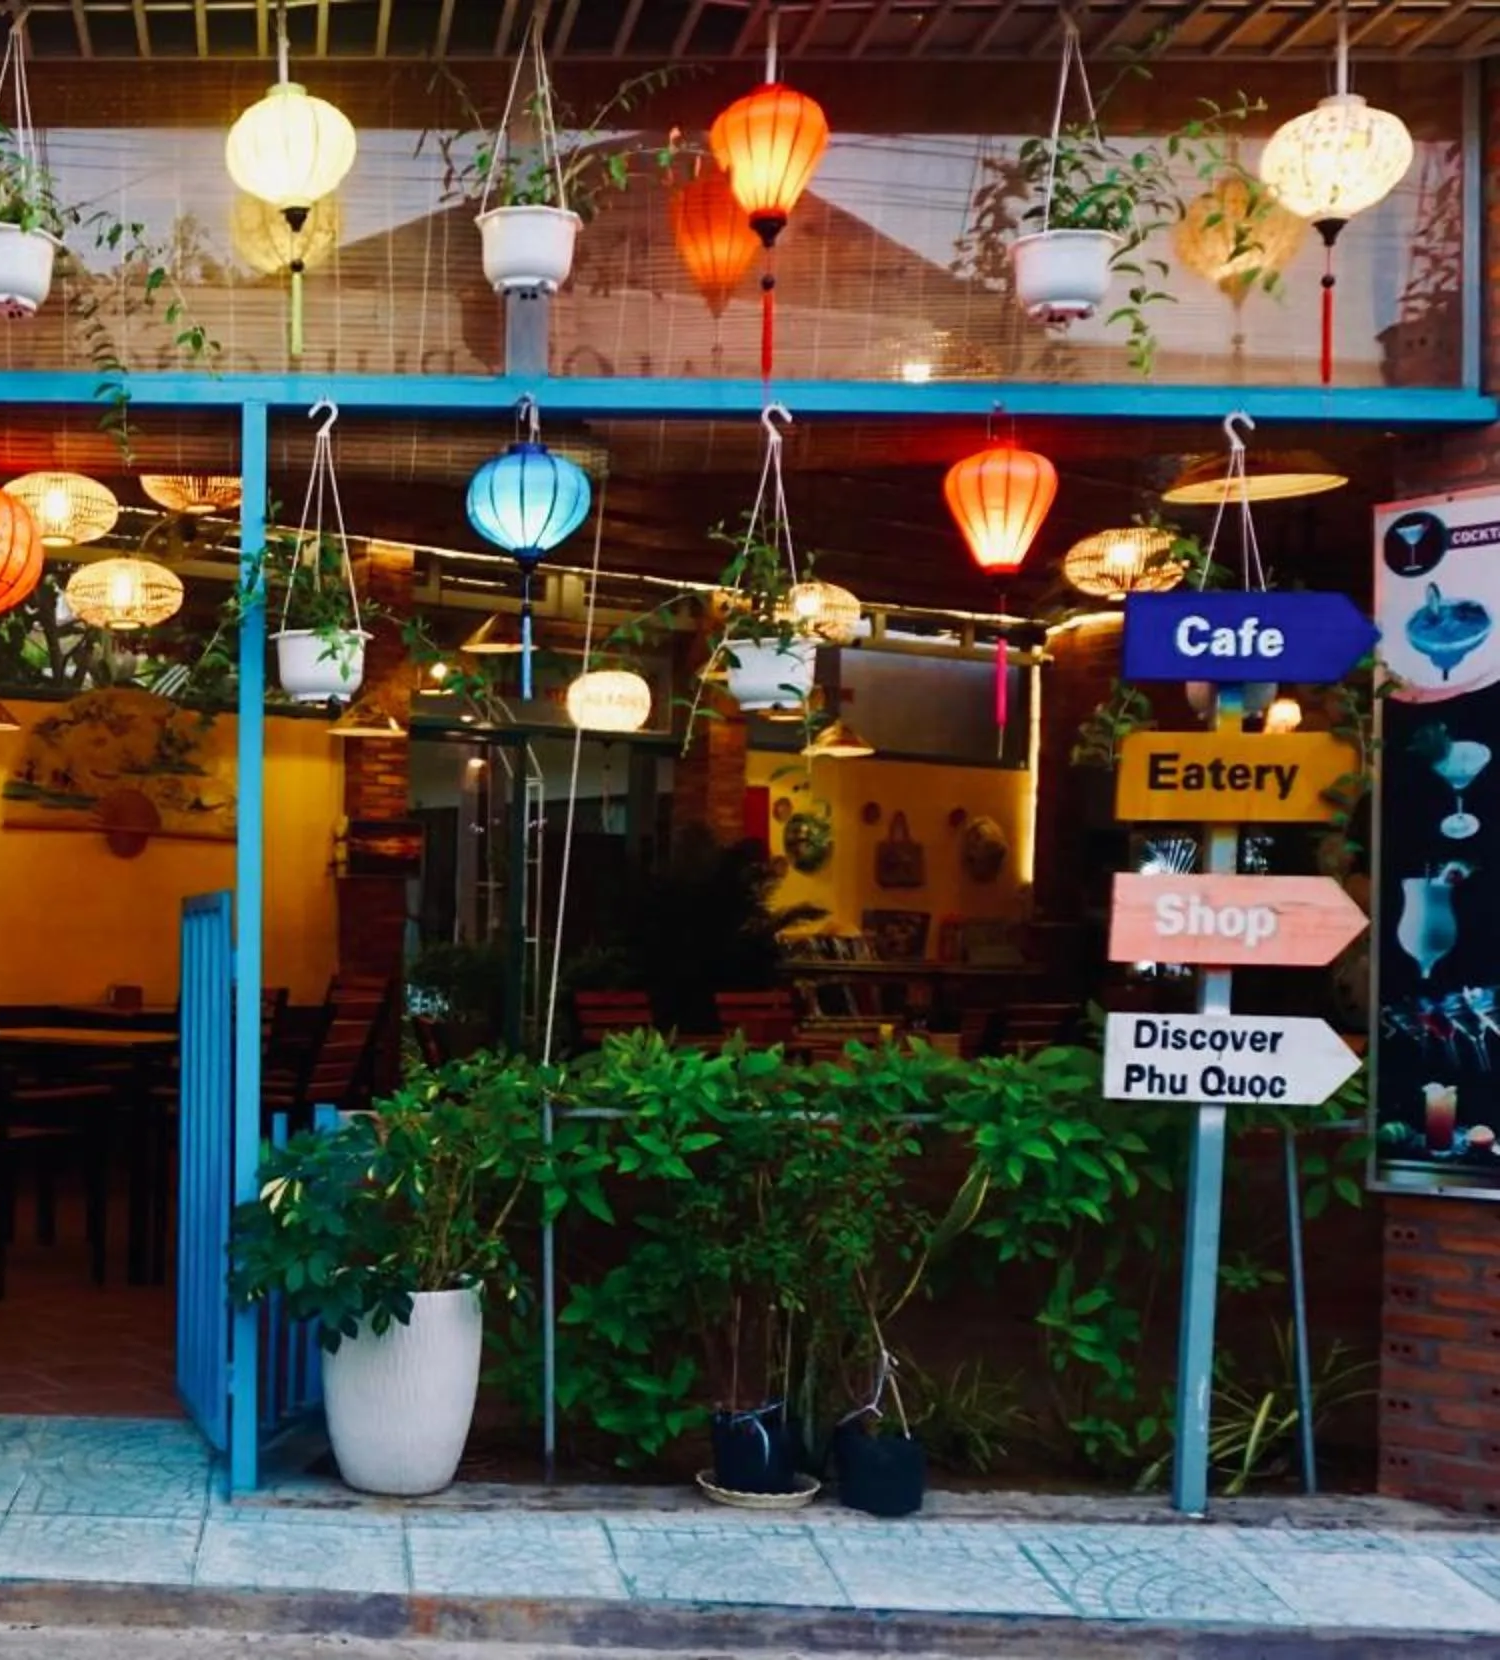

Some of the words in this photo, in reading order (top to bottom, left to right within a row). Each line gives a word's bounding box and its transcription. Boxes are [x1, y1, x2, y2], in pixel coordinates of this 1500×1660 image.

[1451, 528, 1500, 545] COCKT
[1176, 615, 1285, 657] Cafe
[1147, 753, 1299, 801] Eatery
[1155, 893, 1278, 948] Shop
[1133, 1019, 1284, 1053] Discover
[1123, 1063, 1188, 1095] Phu
[1201, 1065, 1287, 1098] Quoc
